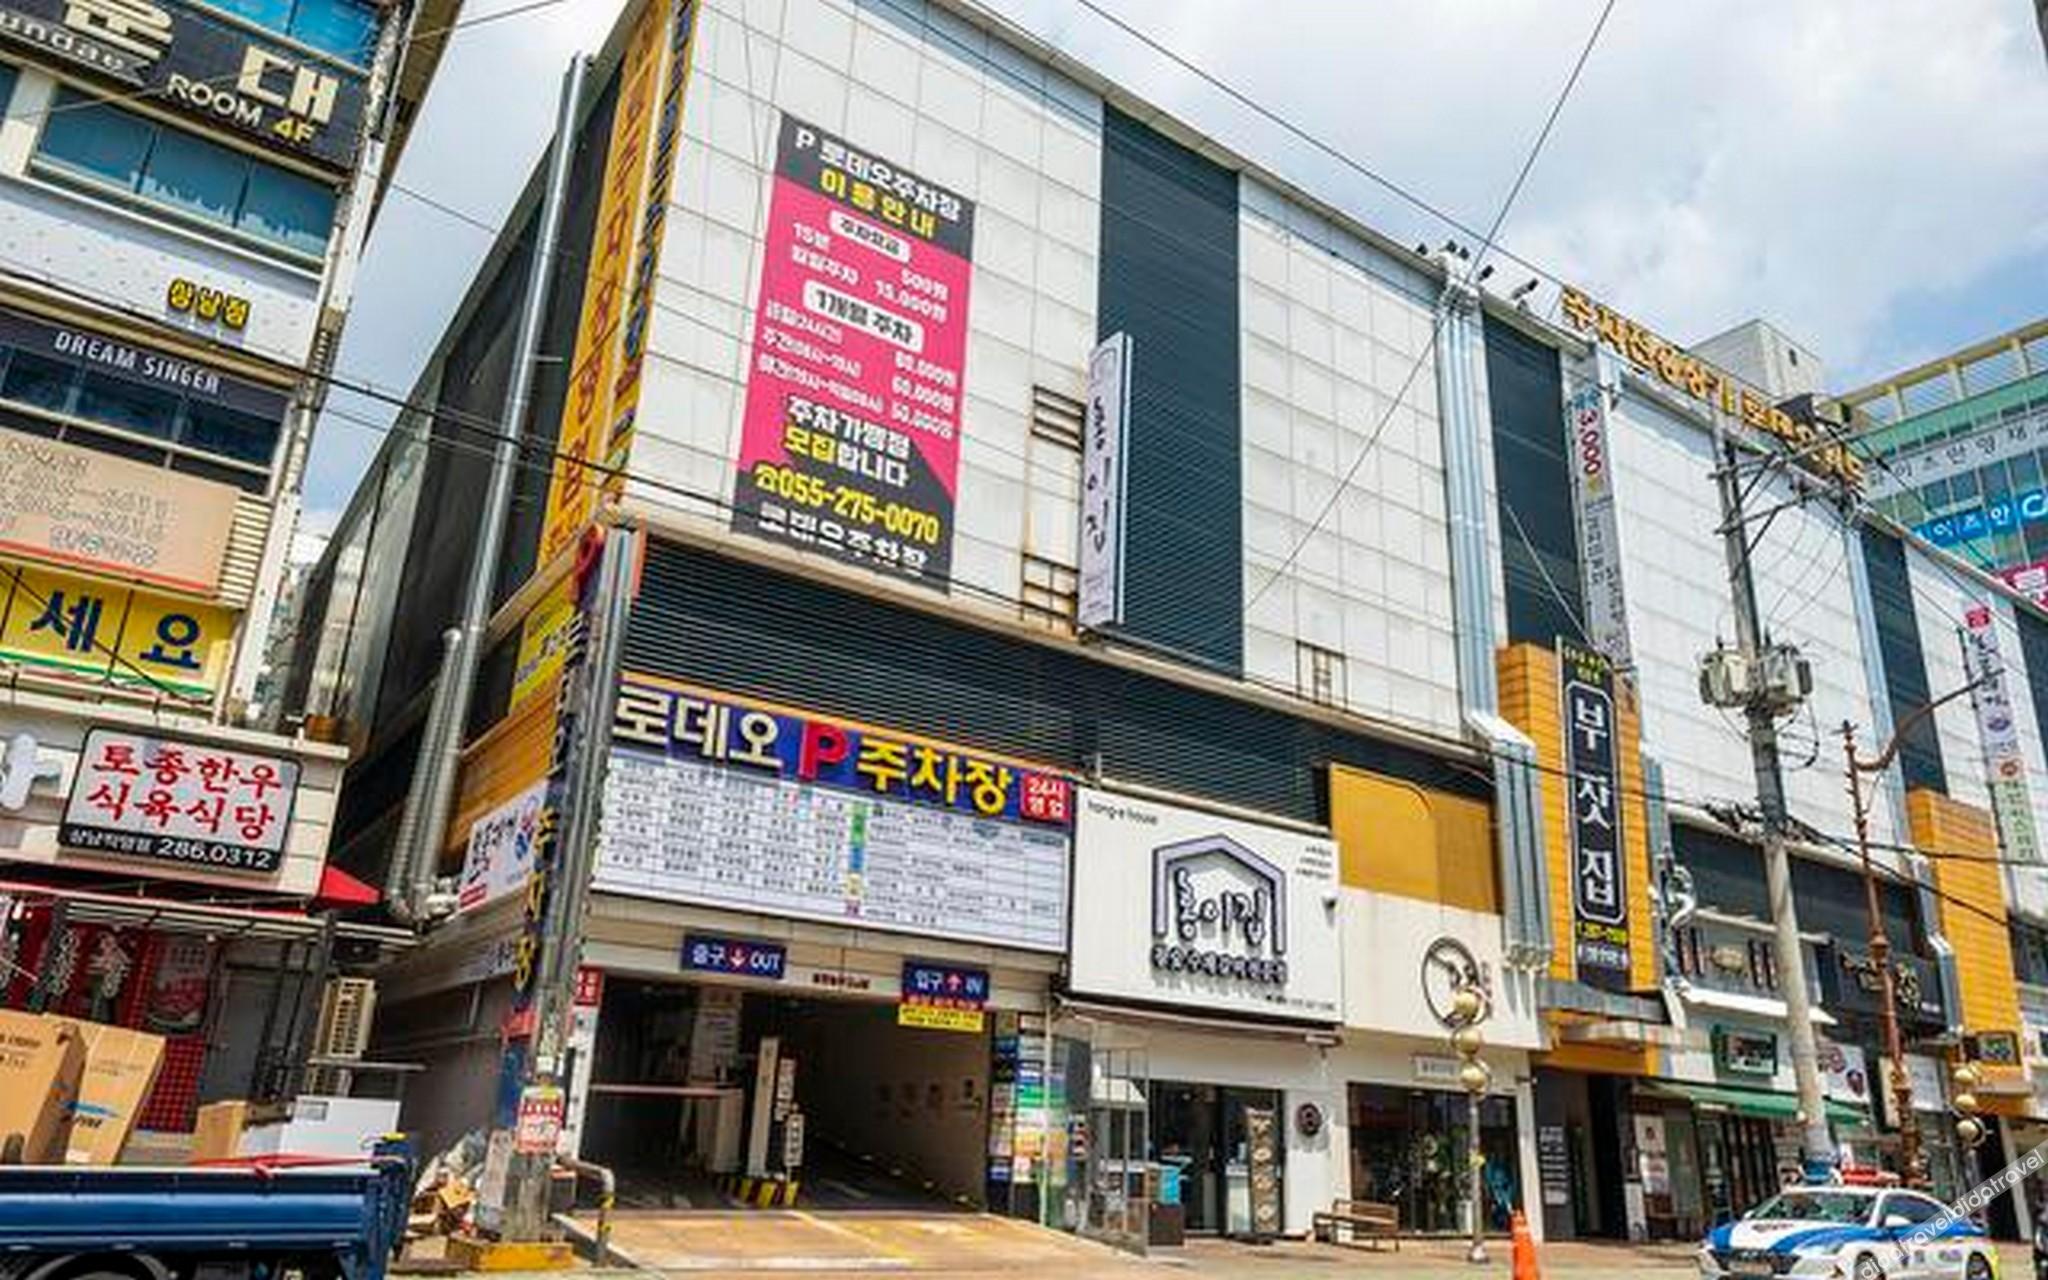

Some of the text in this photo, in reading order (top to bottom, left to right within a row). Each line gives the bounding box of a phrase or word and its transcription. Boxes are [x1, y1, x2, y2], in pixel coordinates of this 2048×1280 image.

[166, 74, 315, 144] ROOM 4F
[795, 128, 962, 222] P 로데오주차장
[873, 312, 914, 346] 주차
[54, 331, 220, 395] DREAM SINGER
[784, 424, 908, 487] 모집합니다
[779, 467, 941, 546] 055-275-0070
[758, 502, 929, 578] 로데오주차장
[29, 590, 201, 670] 세요
[92, 744, 282, 799] 토종한우
[611, 684, 1013, 815] 로데오 P 주차장
[86, 782, 275, 841] 식육식당
[156, 837, 271, 868] 286.0312
[750, 951, 783, 972] OUT
